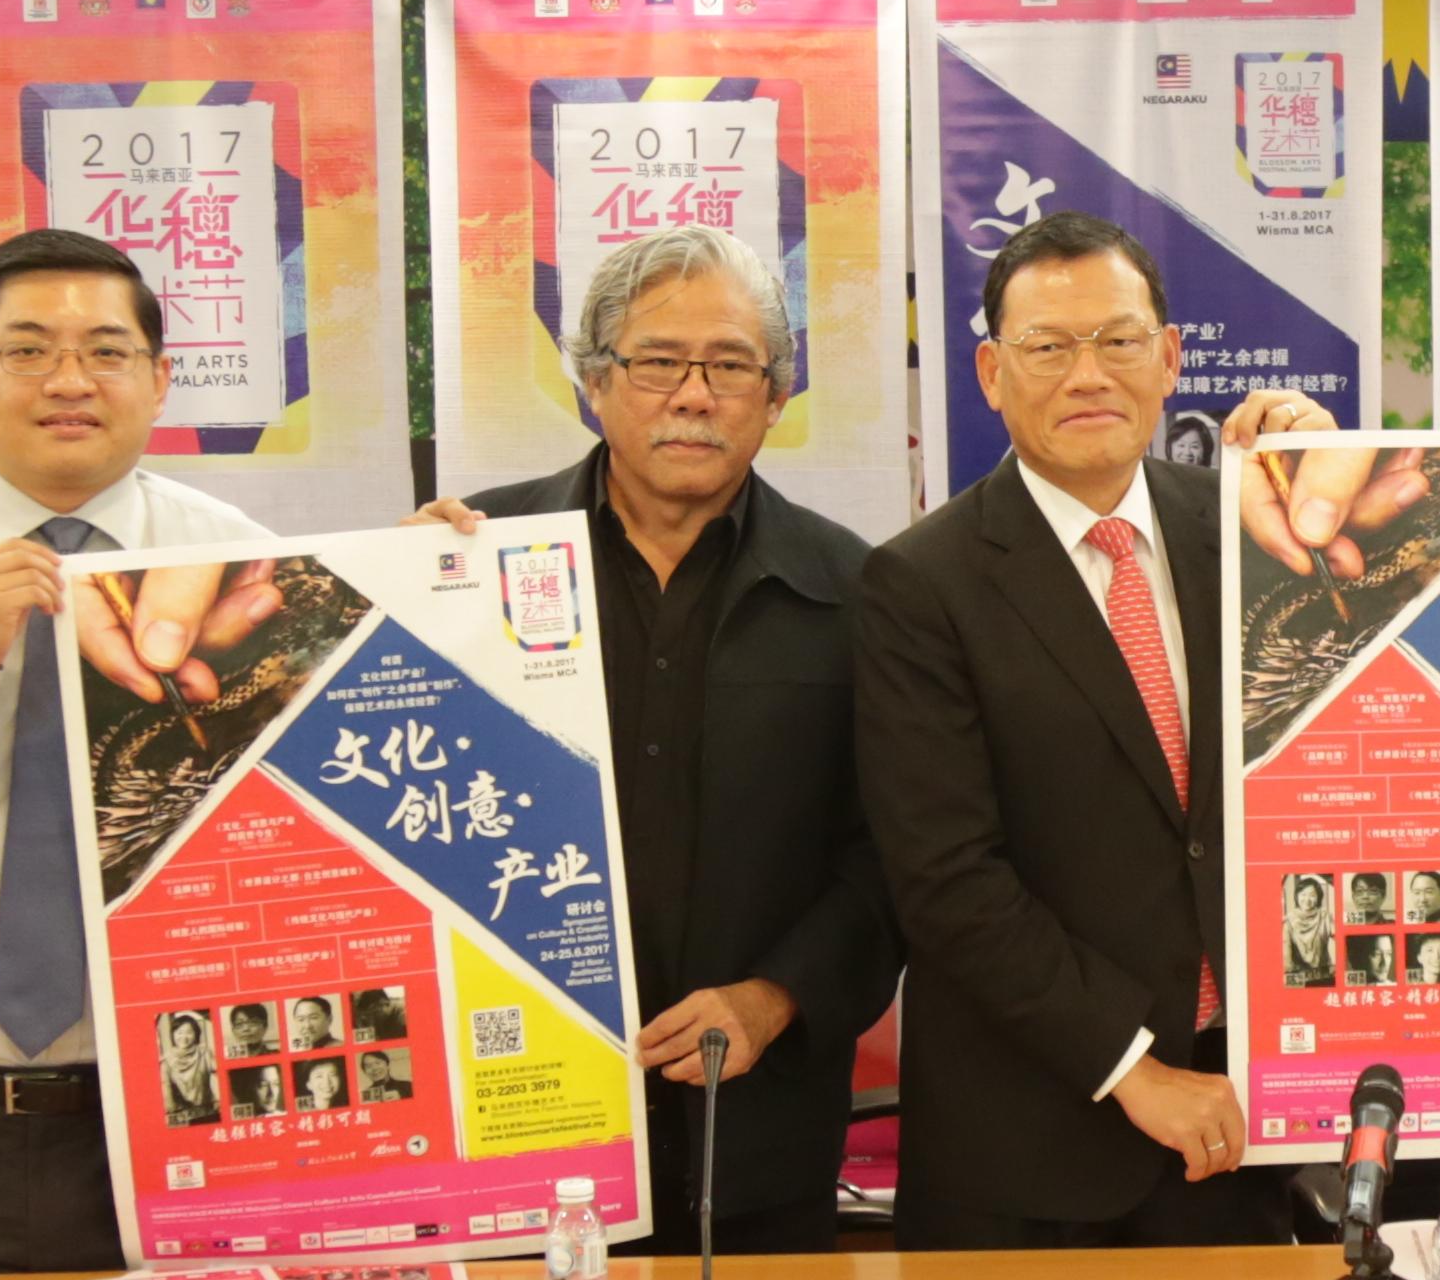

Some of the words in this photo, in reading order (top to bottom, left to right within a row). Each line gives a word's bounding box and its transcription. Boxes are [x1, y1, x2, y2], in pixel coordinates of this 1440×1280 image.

[1258, 71, 1321, 87] 2017
[1143, 94, 1208, 105] NEGARAKU
[1258, 93, 1320, 127] 华穗
[82, 131, 242, 167] 2017
[590, 127, 746, 161] 2017
[1258, 128, 1321, 153] 艺术节
[130, 166, 193, 184] 马来西亚
[636, 162, 699, 178] 马来西亚
[1259, 210, 1332, 221] 1-31.8.2017
[85, 182, 244, 270] 华穗
[1256, 225, 1299, 236] Wisma
[1303, 224, 1334, 235] MCA
[1169, 323, 1225, 341] 产业?
[196, 354, 249, 370] ARTS
[515, 557, 560, 571] 2017
[431, 582, 480, 593] NEGARAKU
[517, 573, 561, 600] 华穗
[489, 843, 603, 922] 产业
[476, 1083, 529, 1100] 03-2203
[531, 1079, 561, 1094] 3979
